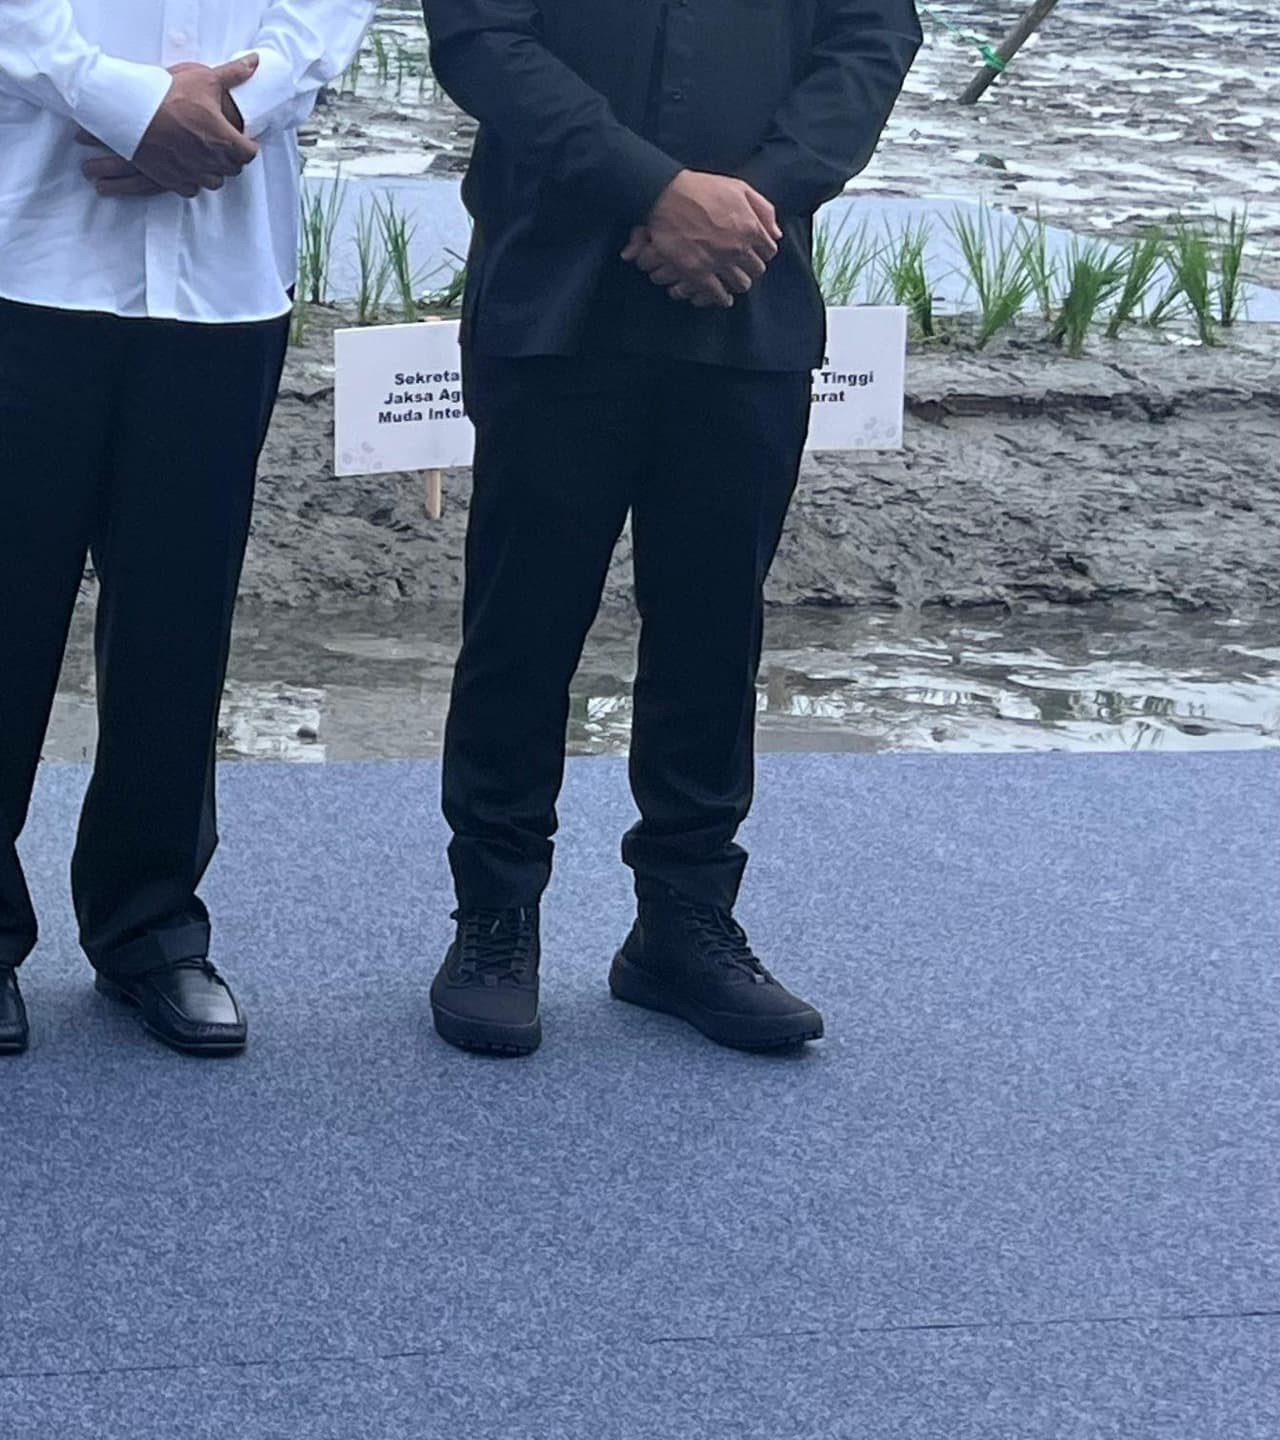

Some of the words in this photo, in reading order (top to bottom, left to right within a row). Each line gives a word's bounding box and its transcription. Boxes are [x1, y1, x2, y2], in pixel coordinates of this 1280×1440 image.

[821, 370, 874, 386] Tinggi
[383, 392, 433, 405] Jaksa
[378, 410, 422, 423] Muda
